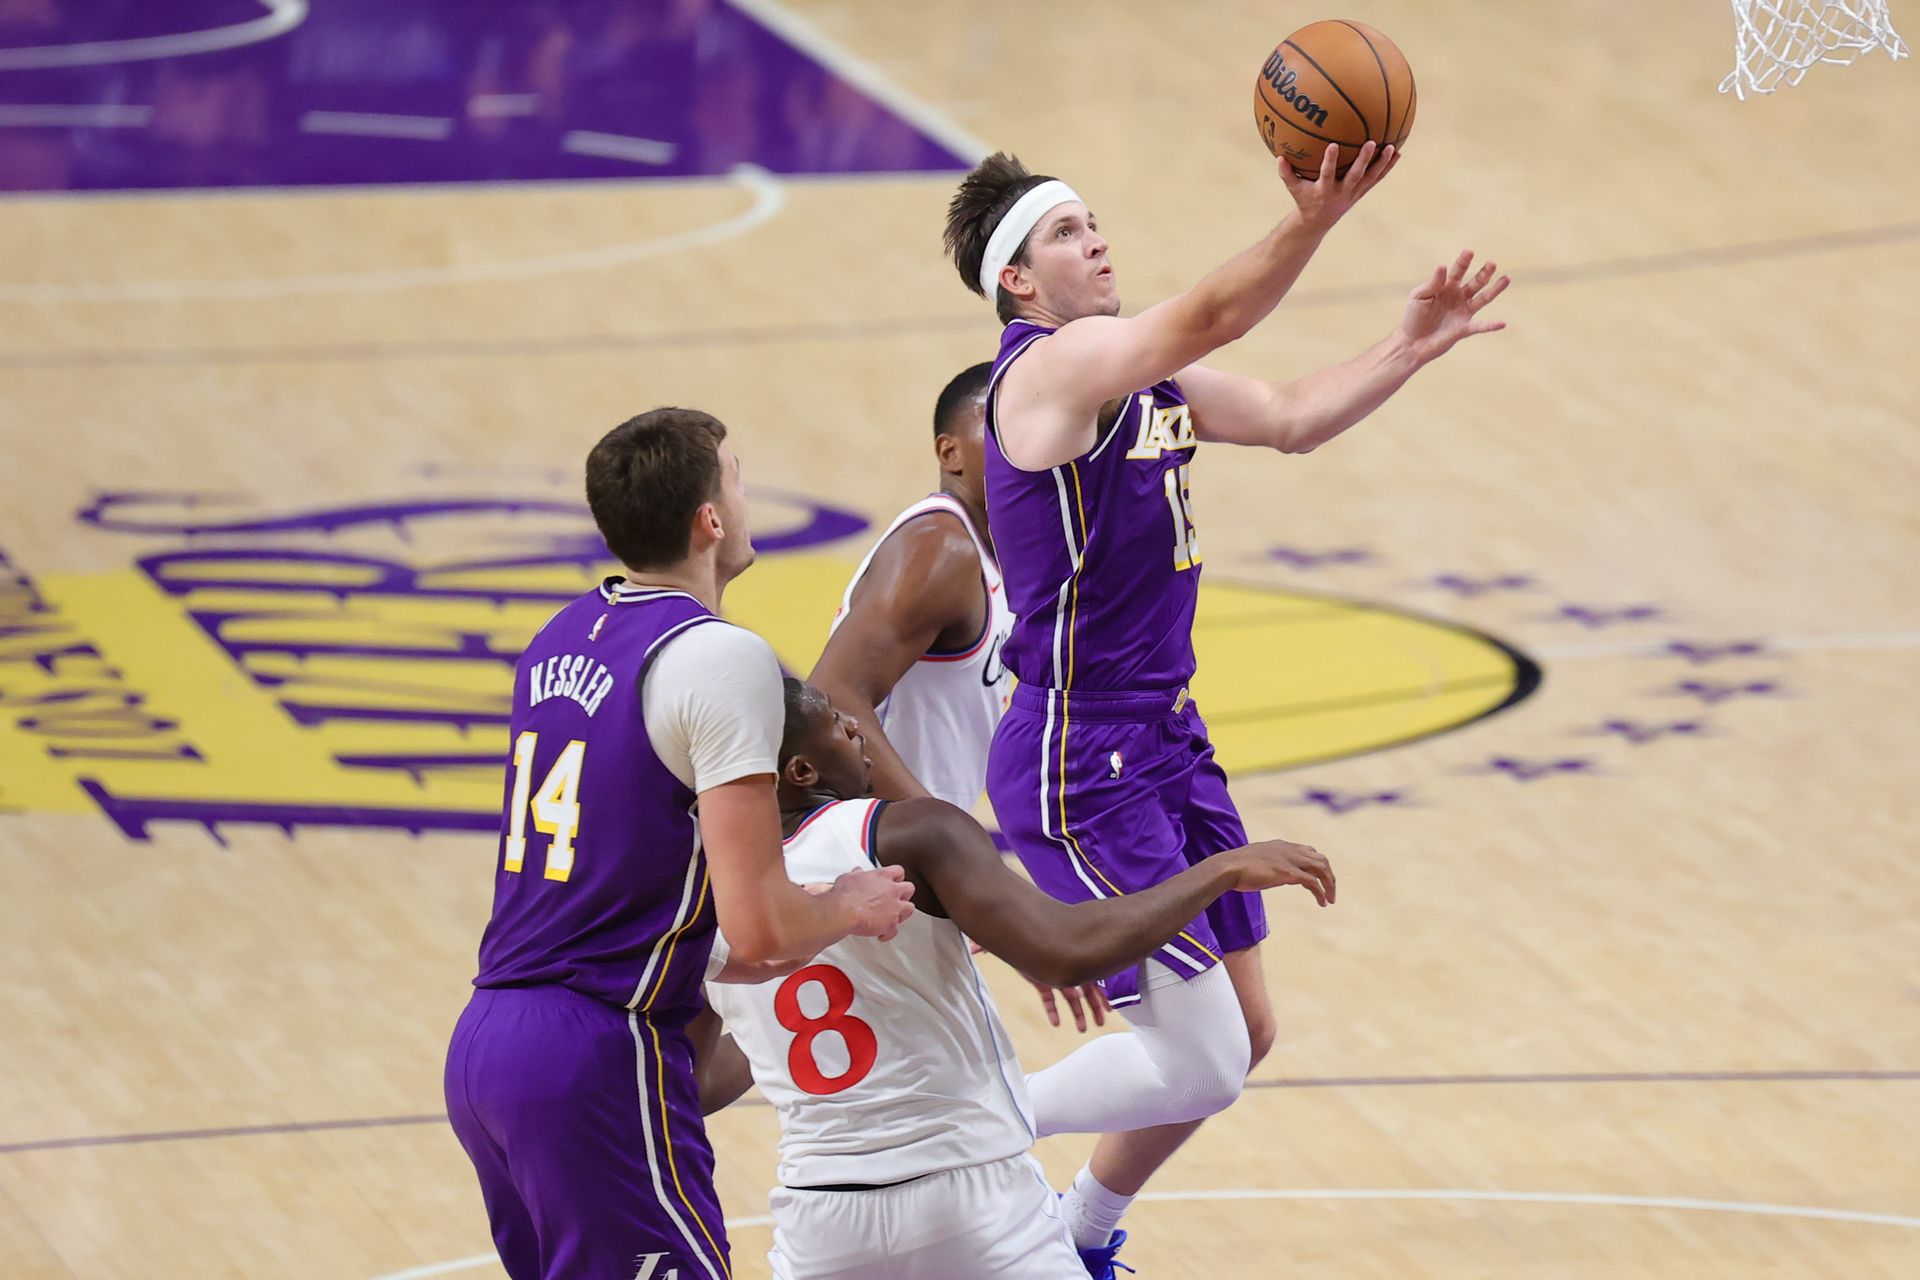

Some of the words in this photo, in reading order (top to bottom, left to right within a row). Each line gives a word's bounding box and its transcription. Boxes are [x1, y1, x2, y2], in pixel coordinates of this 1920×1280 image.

[1263, 50, 1329, 129] Wilson
[530, 654, 614, 718] KESSLER
[504, 731, 587, 883] 14
[774, 964, 878, 1095] 8
